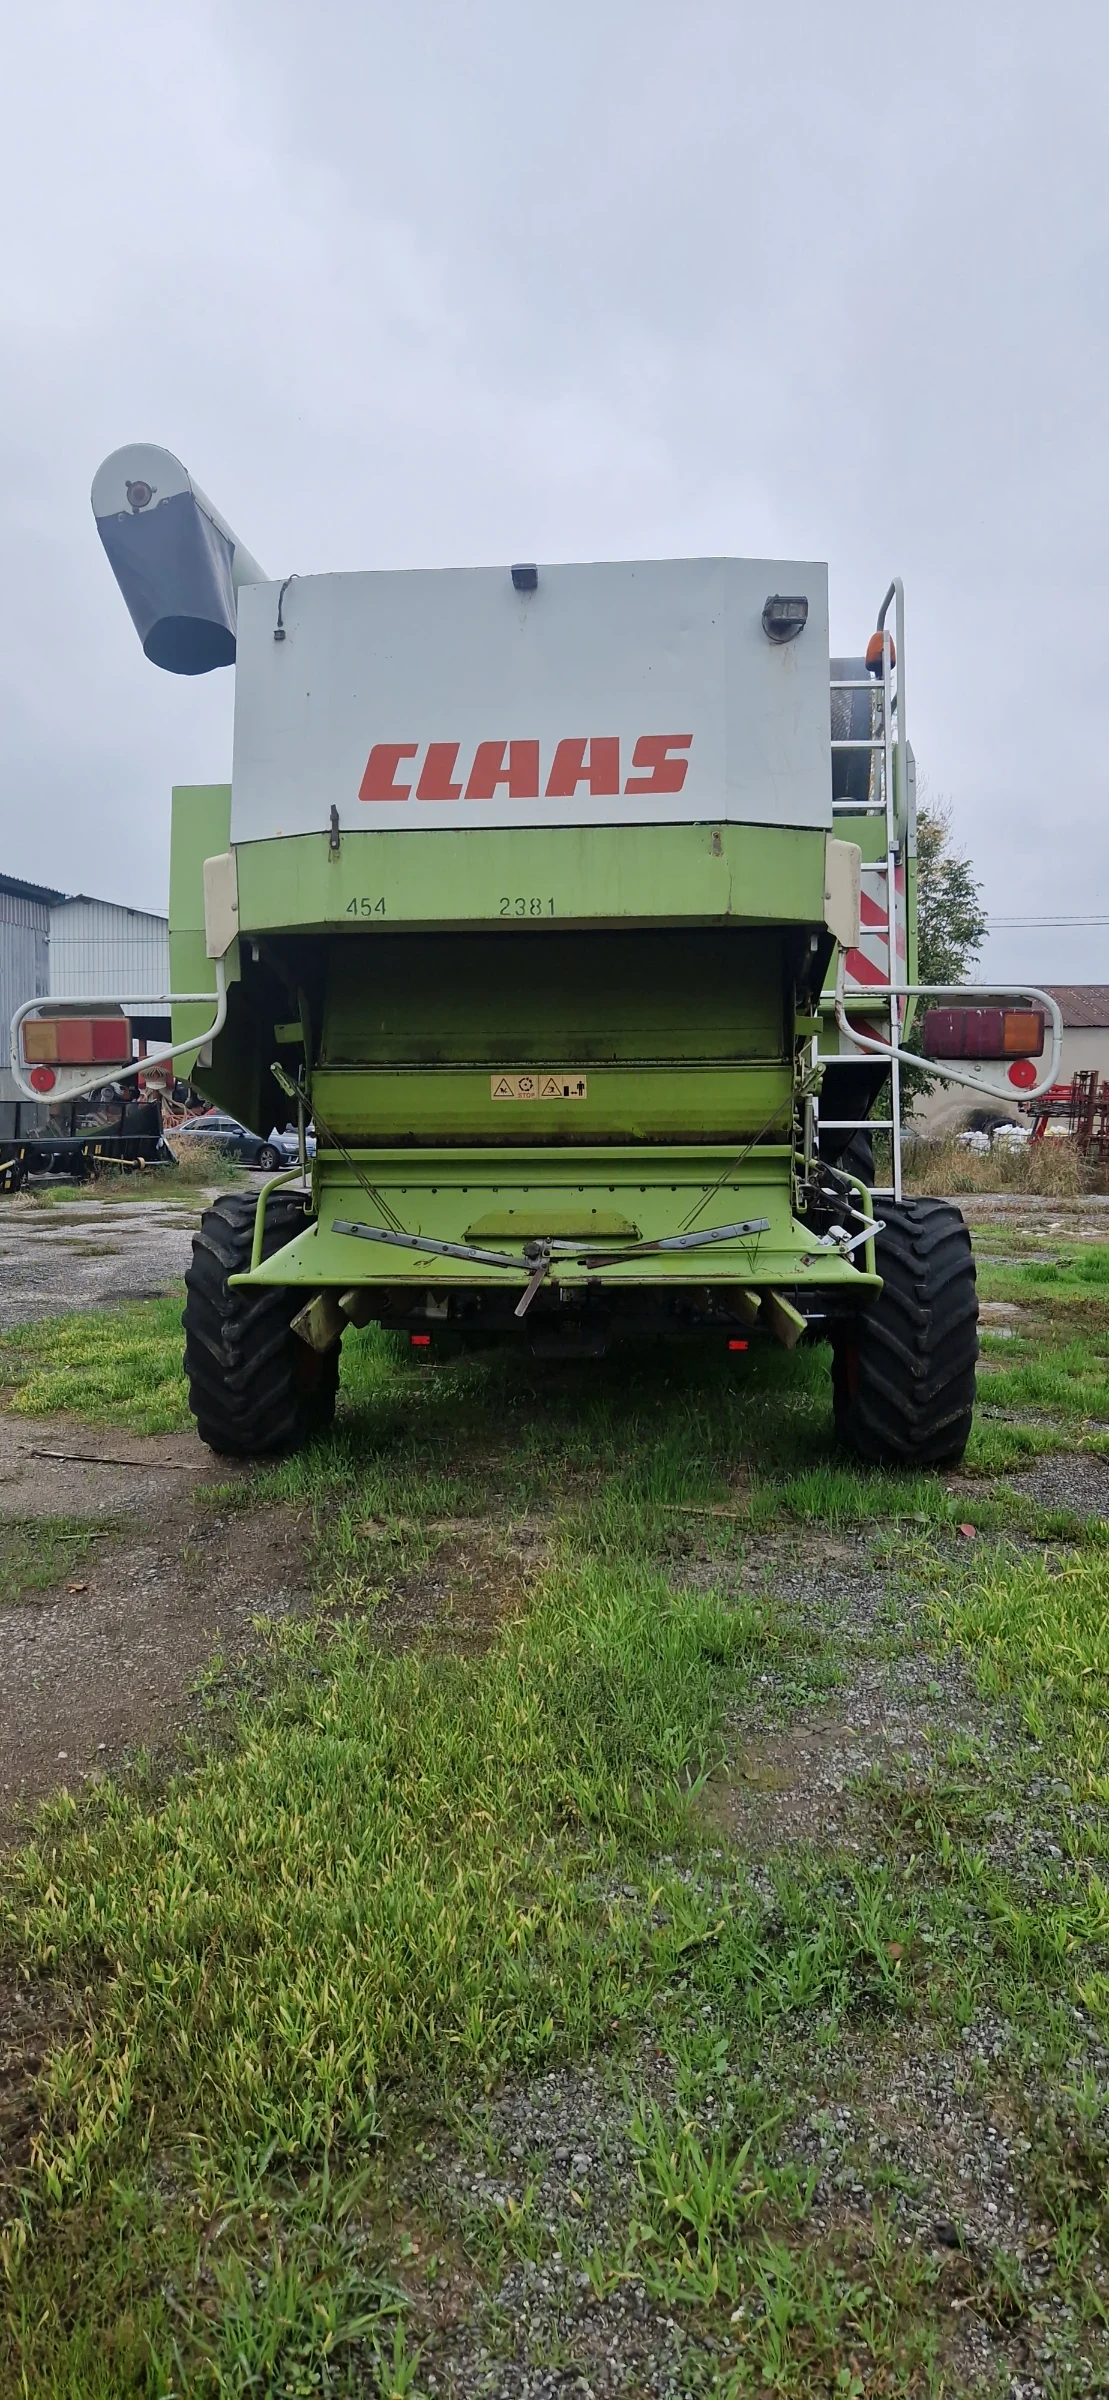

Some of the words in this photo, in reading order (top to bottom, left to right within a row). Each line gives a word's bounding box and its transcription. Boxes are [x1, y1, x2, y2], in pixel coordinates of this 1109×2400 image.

[358, 734, 693, 801] CLAAS
[346, 897, 386, 916] 454
[500, 897, 555, 916] 2381
